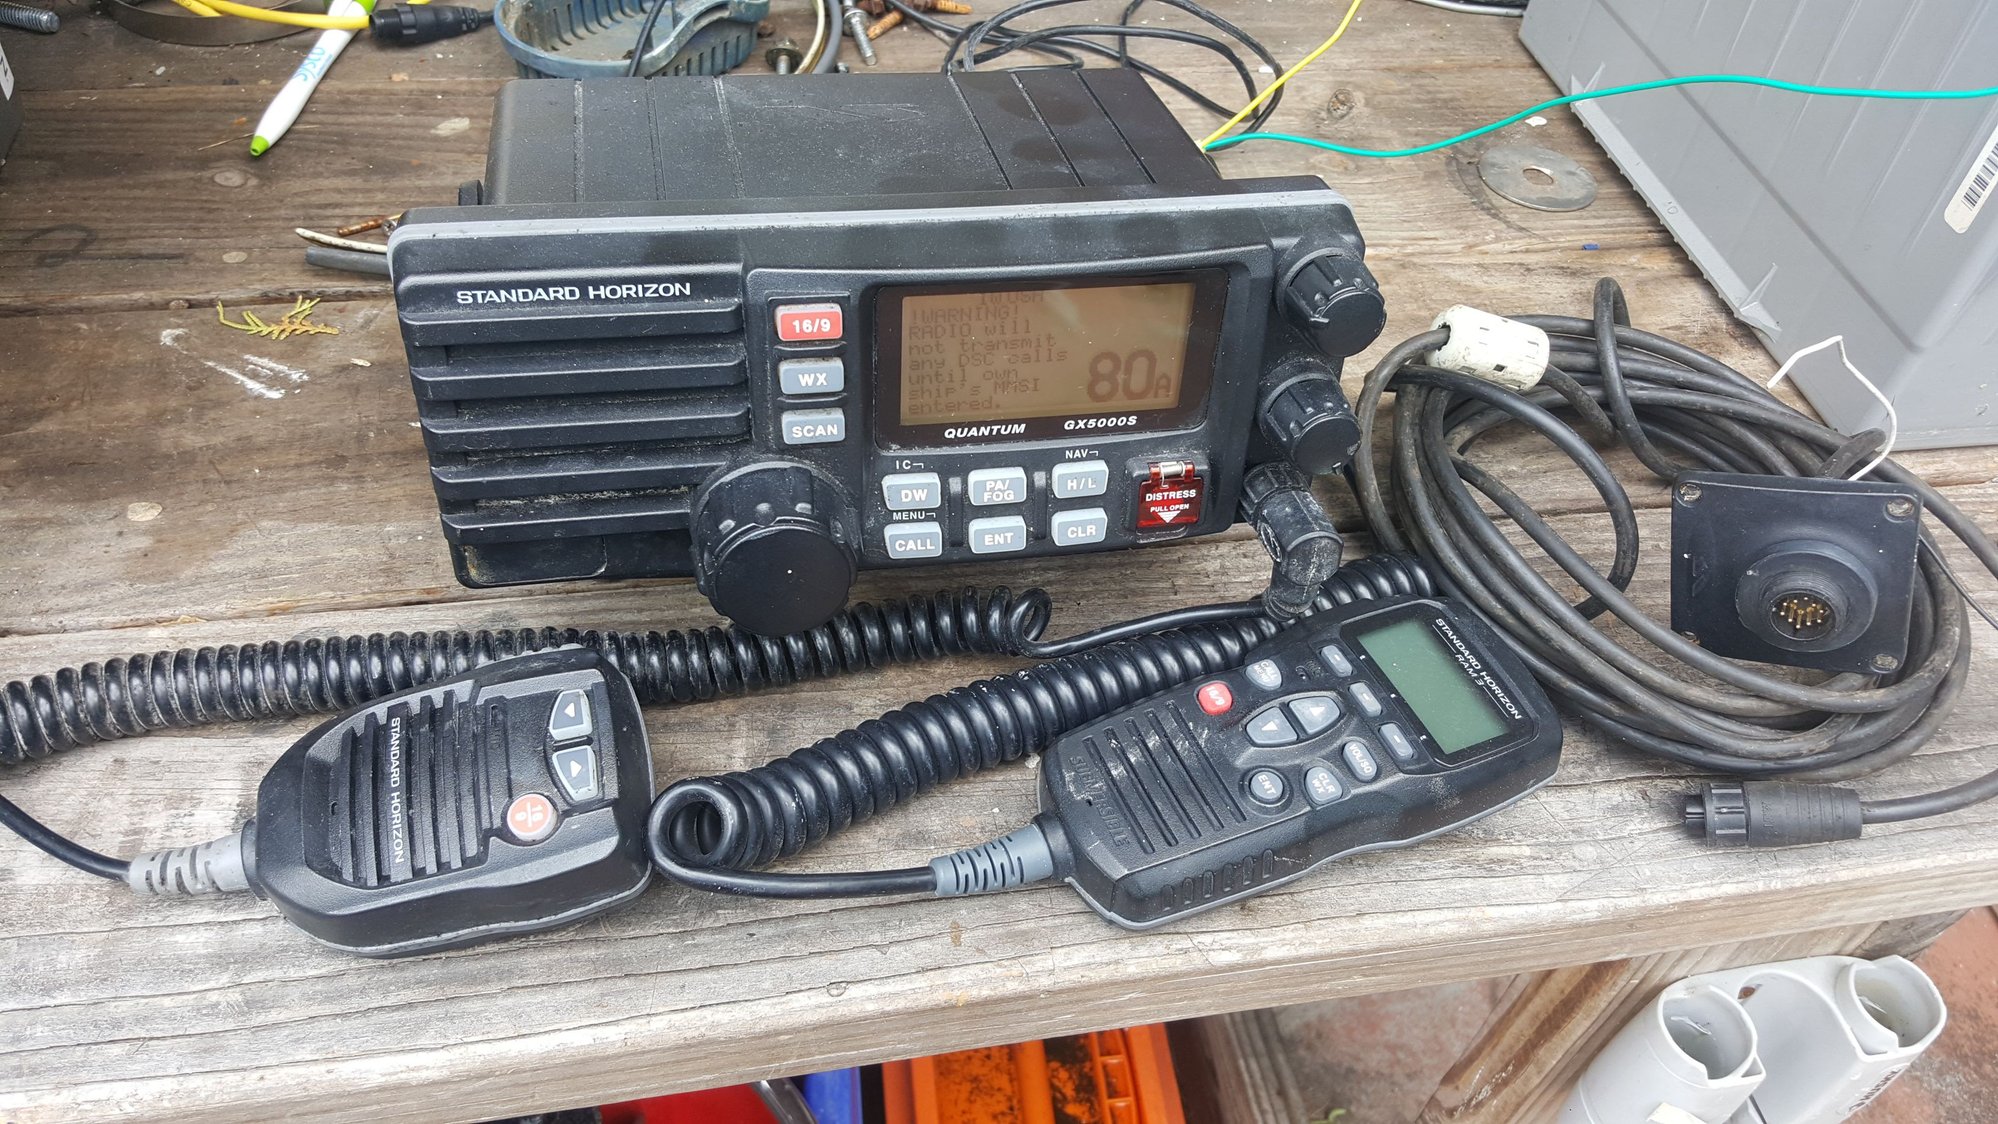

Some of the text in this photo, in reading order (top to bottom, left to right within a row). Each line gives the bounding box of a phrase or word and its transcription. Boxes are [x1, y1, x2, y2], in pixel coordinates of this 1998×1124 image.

[456, 282, 692, 304] STANDARD HORIZON
[912, 305, 1019, 324] !WARNING!
[792, 318, 831, 334] 16/9
[908, 319, 1031, 341] RADIO will
[908, 333, 1057, 356] not transmit
[909, 349, 1068, 371] any DSC calls
[798, 372, 828, 387] WX
[908, 368, 1018, 386] until own
[908, 378, 1041, 400] ship's MMSI
[908, 396, 1001, 415] entered.
[792, 424, 838, 438] SCAN
[944, 423, 1026, 439] QUANTUM
[1063, 415, 1138, 431] GX5000S
[1065, 449, 1088, 459] NAV
[985, 480, 1010, 492] PA/
[1066, 478, 1097, 490] H/L
[901, 488, 928, 502] DW
[983, 490, 1014, 502] FOG
[1145, 489, 1197, 502] DISTRESS
[892, 511, 926, 521] MENU
[1150, 503, 1190, 513] PULL OPEN
[984, 532, 1014, 546] ENT
[1066, 524, 1097, 538] CLR
[895, 539, 935, 552] CALL
[1260, 661, 1279, 678] CALL
[1435, 618, 1522, 720] STANDARD HORIZON
[1455, 654, 1485, 686] RAM 3
[1206, 686, 1225, 706] 16/9
[1349, 743, 1373, 774] VOL/SQ
[390, 716, 405, 864] STANDARD HORIZON
[1257, 774, 1277, 796] ENT
[1311, 778, 1326, 794] WX
[1318, 772, 1336, 794] CLR
